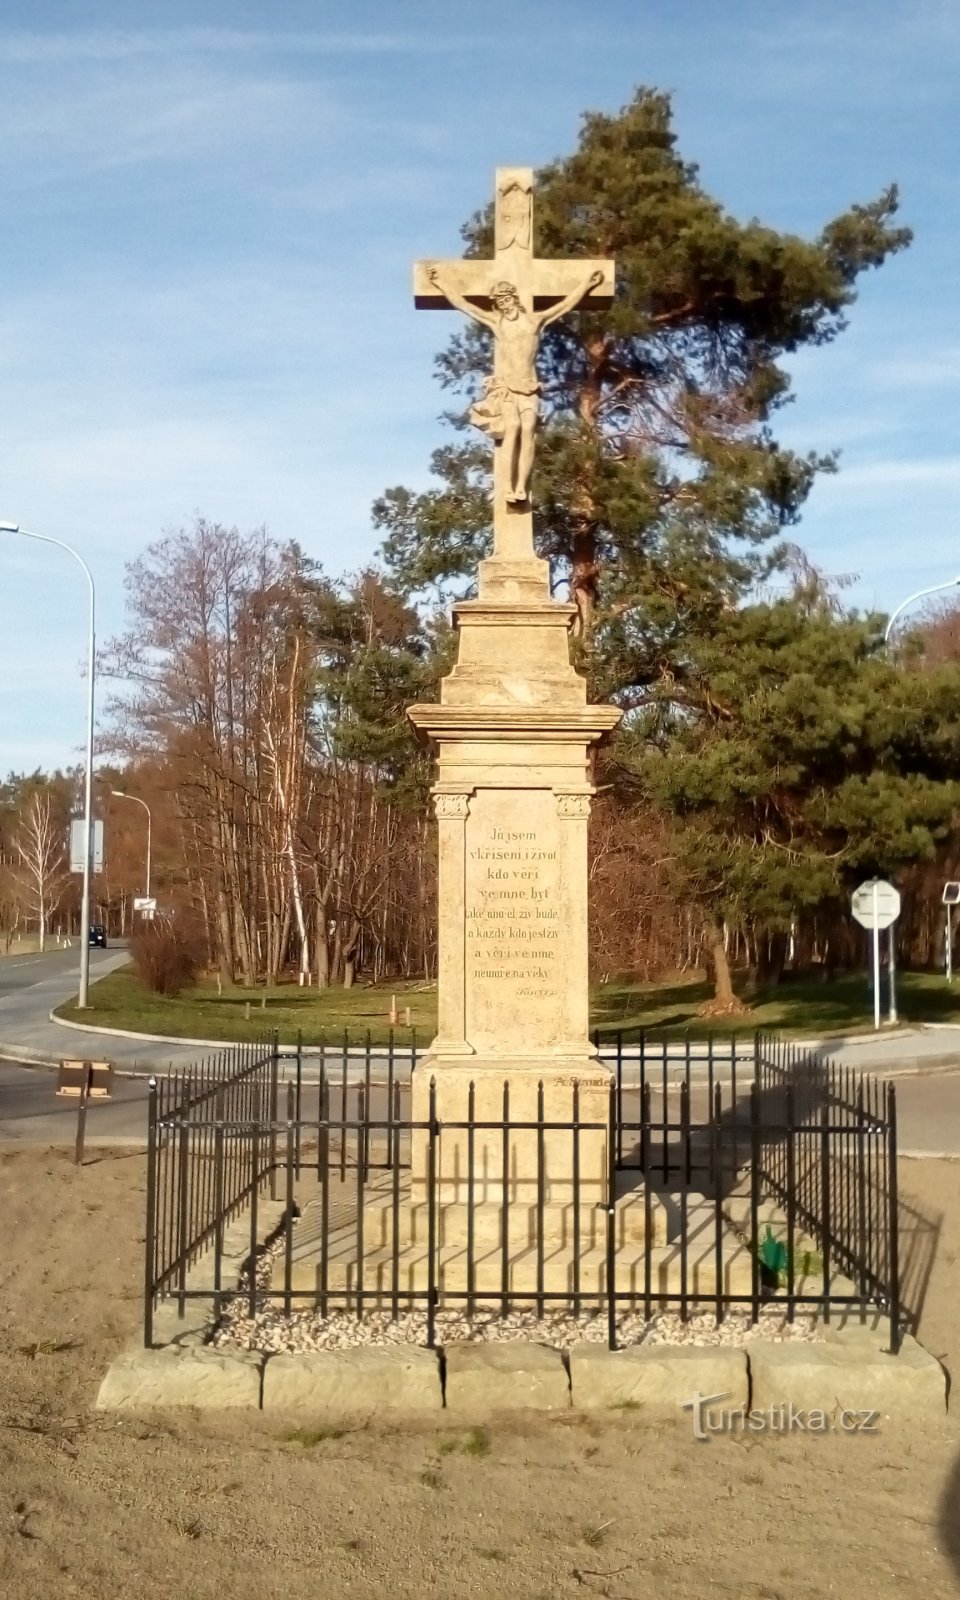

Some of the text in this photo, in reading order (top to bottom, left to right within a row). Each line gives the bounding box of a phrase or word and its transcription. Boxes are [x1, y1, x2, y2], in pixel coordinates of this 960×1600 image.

[505, 830, 536, 844] jsem
[487, 867, 509, 879] kdo
[468, 930, 474, 938] a
[509, 926, 527, 938] kdo
[474, 950, 481, 958] a
[514, 950, 529, 958] ve
[513, 970, 525, 978] na
